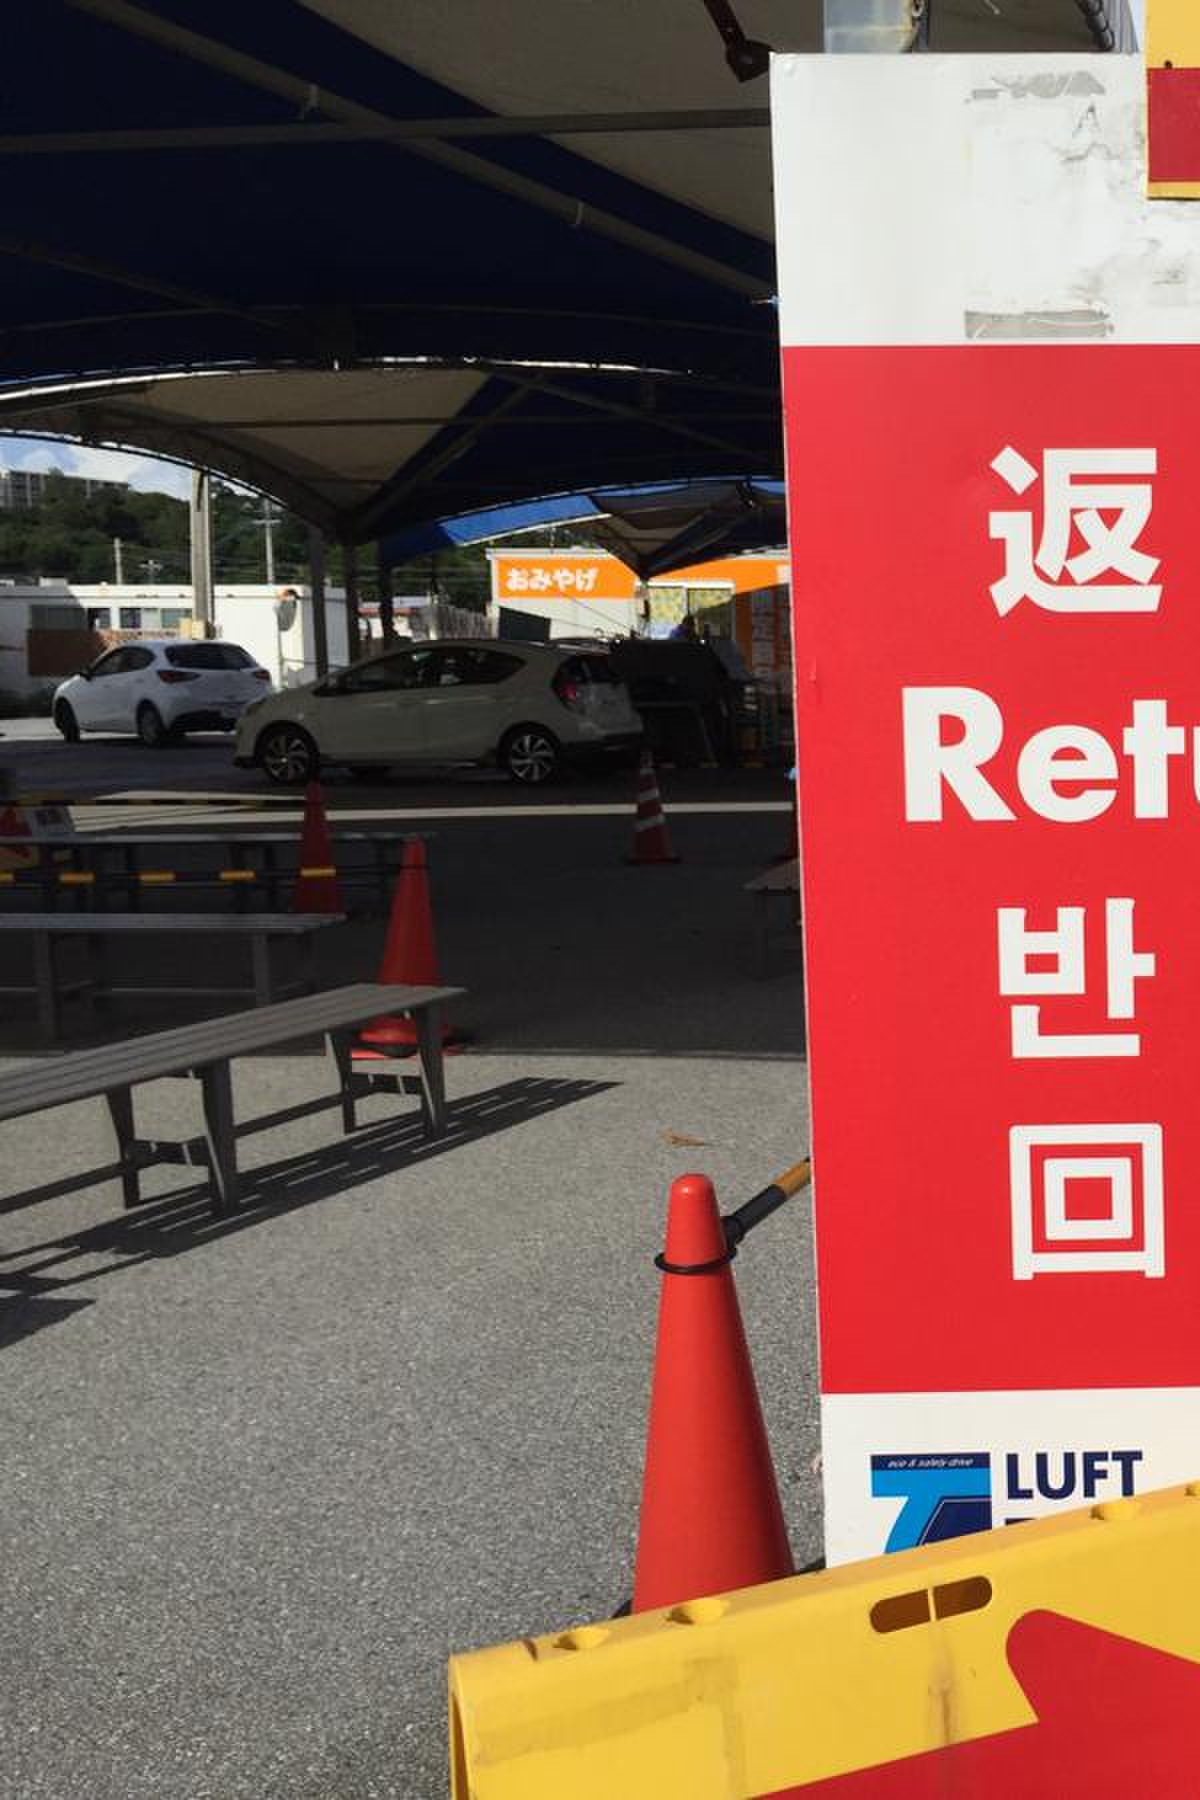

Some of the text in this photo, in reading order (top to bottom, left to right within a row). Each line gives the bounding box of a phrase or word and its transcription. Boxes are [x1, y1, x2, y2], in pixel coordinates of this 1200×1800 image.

[506, 567, 599, 593] おみやげ
[1006, 1450, 1143, 1500] LUFT
